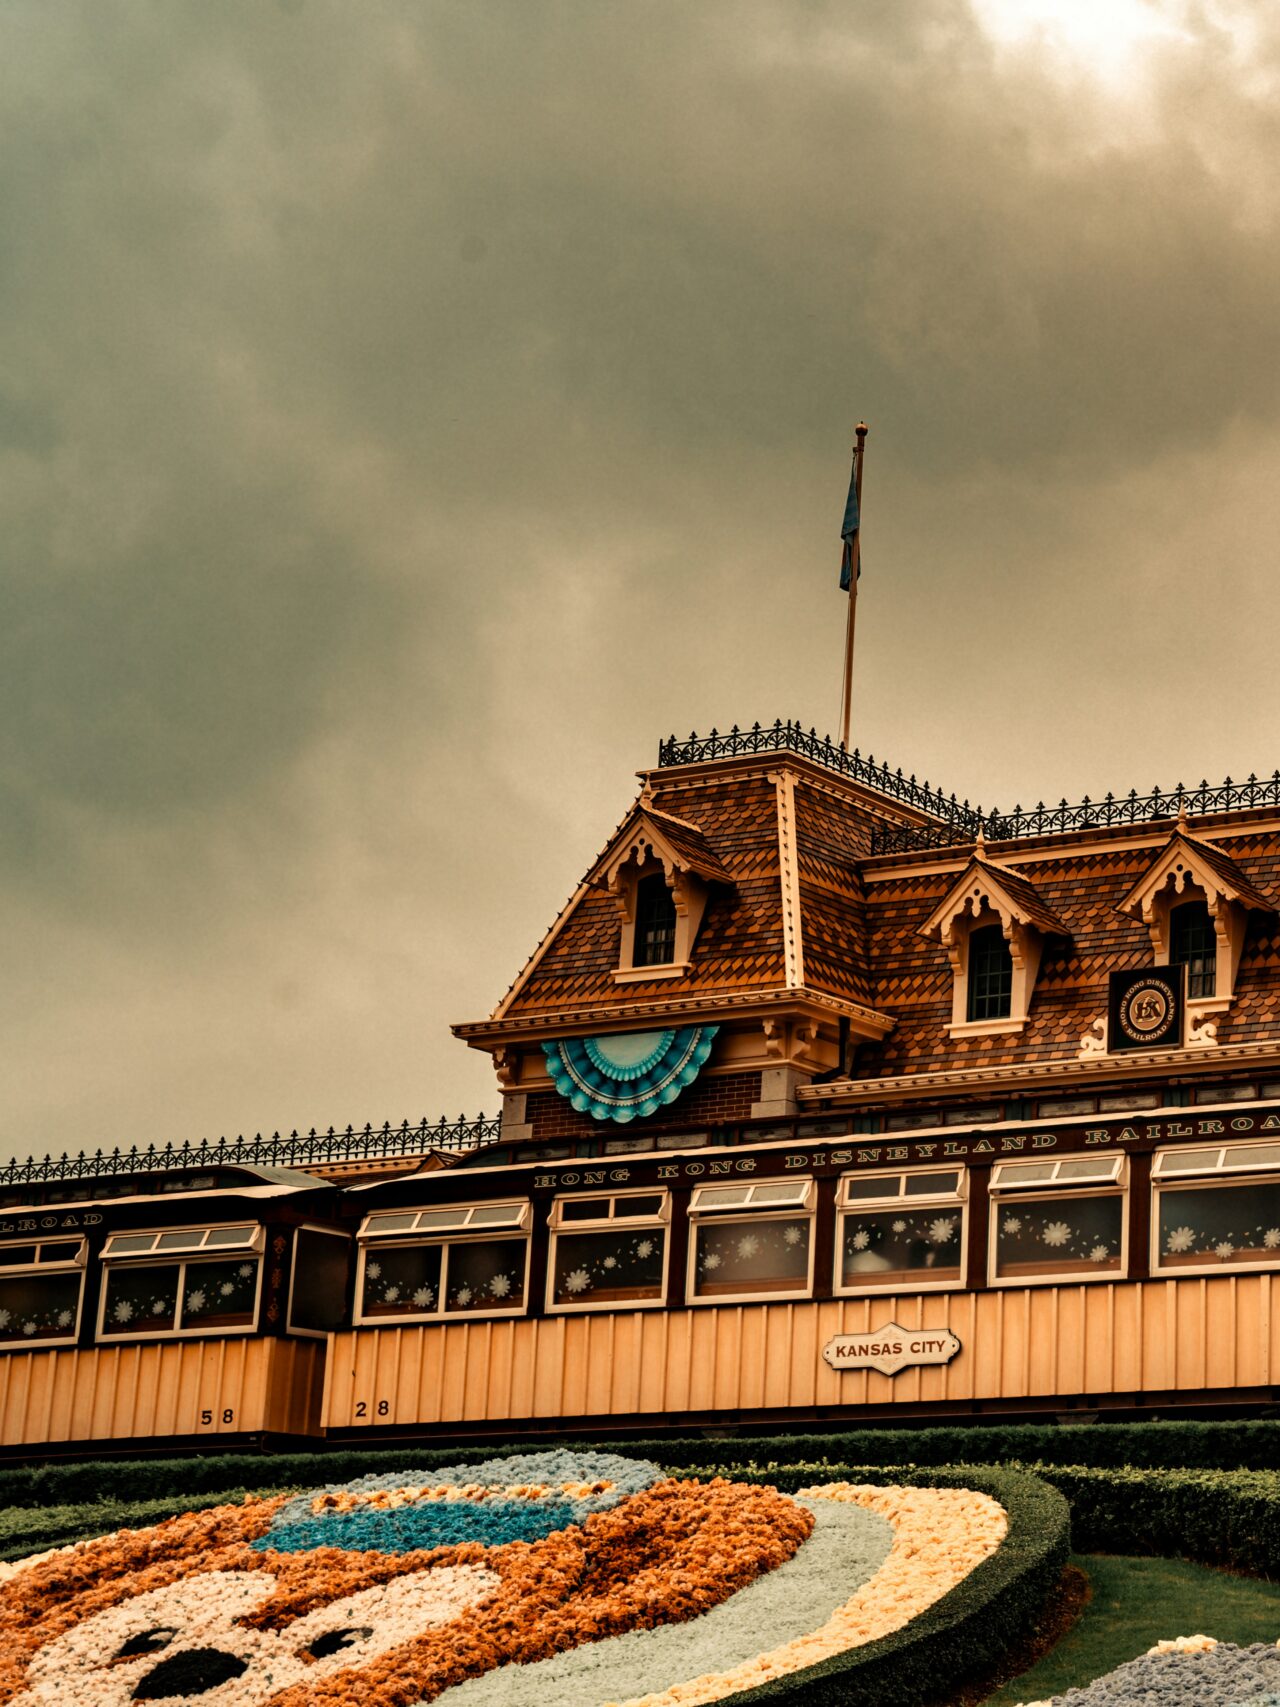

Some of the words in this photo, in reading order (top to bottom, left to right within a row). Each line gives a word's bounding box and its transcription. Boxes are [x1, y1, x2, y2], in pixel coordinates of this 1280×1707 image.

[1120, 1000, 1128, 1026] HONG
[1125, 980, 1145, 999] KONG
[1147, 979, 1175, 1021] DISNEYLAND
[1126, 1025, 1167, 1041] RAILROAD
[534, 1168, 630, 1188] HONG
[657, 1158, 757, 1179] KONG
[784, 1134, 1057, 1169] DISNEYLAND
[835, 1342, 903, 1358] KANSAS
[909, 1340, 946, 1354] CITY
[200, 1408, 234, 1426] 58
[354, 1400, 389, 1418] 28
